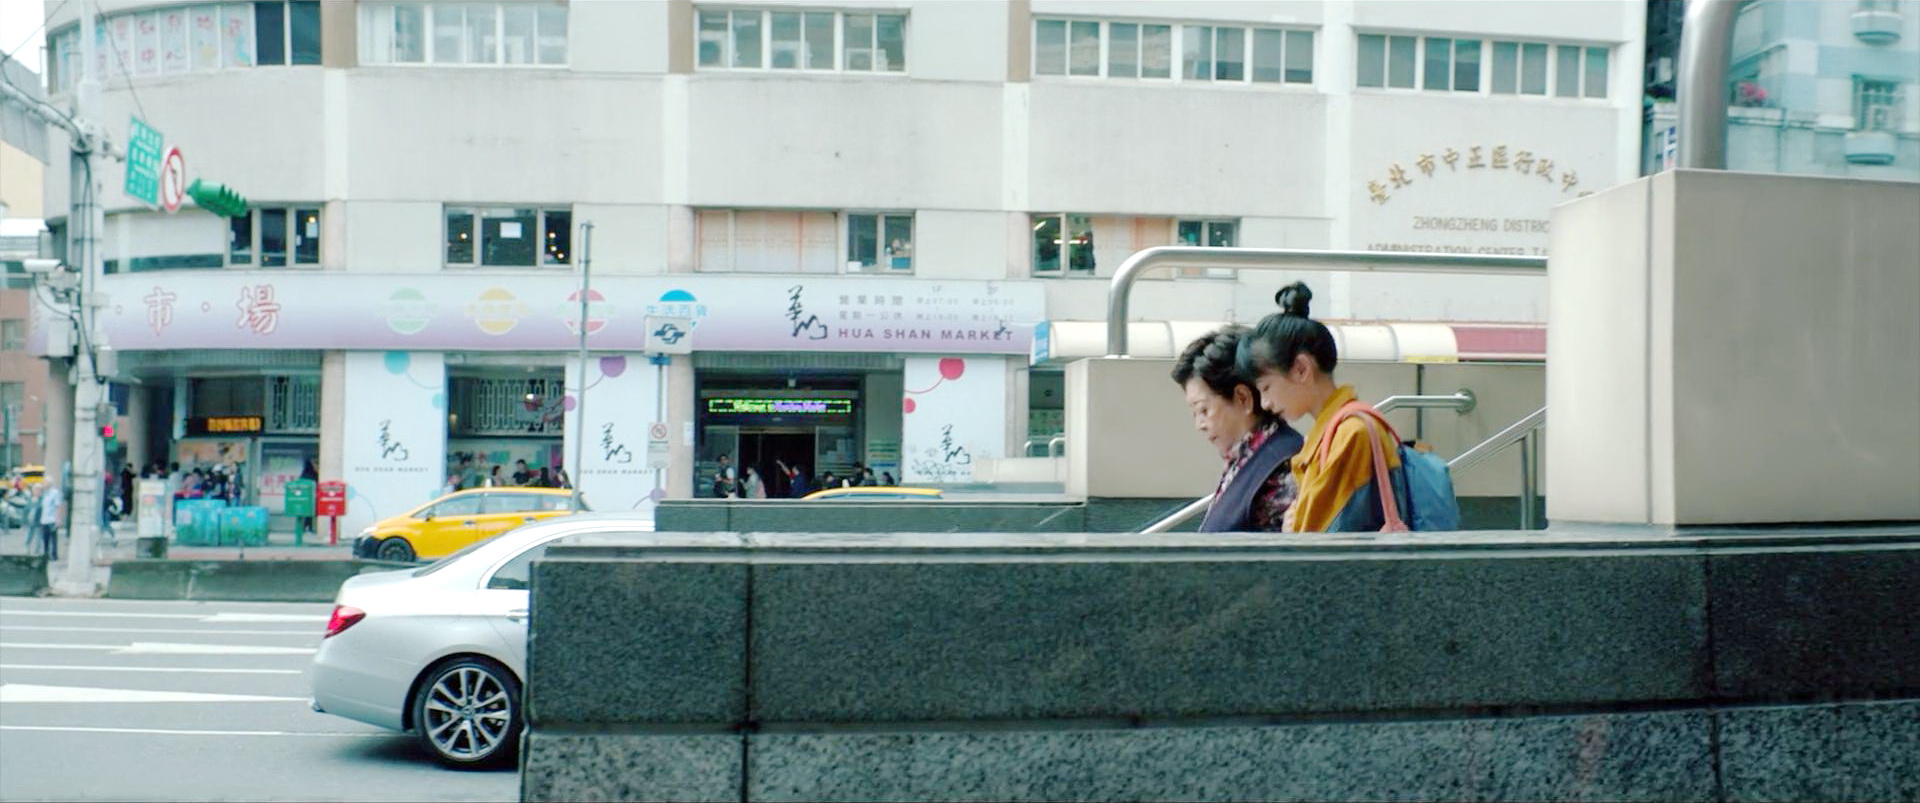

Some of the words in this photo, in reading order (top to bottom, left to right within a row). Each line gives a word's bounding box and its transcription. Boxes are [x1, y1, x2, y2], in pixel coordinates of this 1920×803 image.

[1367, 145, 1594, 205] 臺北市中正區行政中
[1413, 216, 1498, 232] ZHONGZHENG
[1503, 218, 1551, 234] DISTRIC
[838, 328, 873, 339] HUA
[884, 328, 932, 340] SHAN
[941, 329, 1014, 341] MARKET
